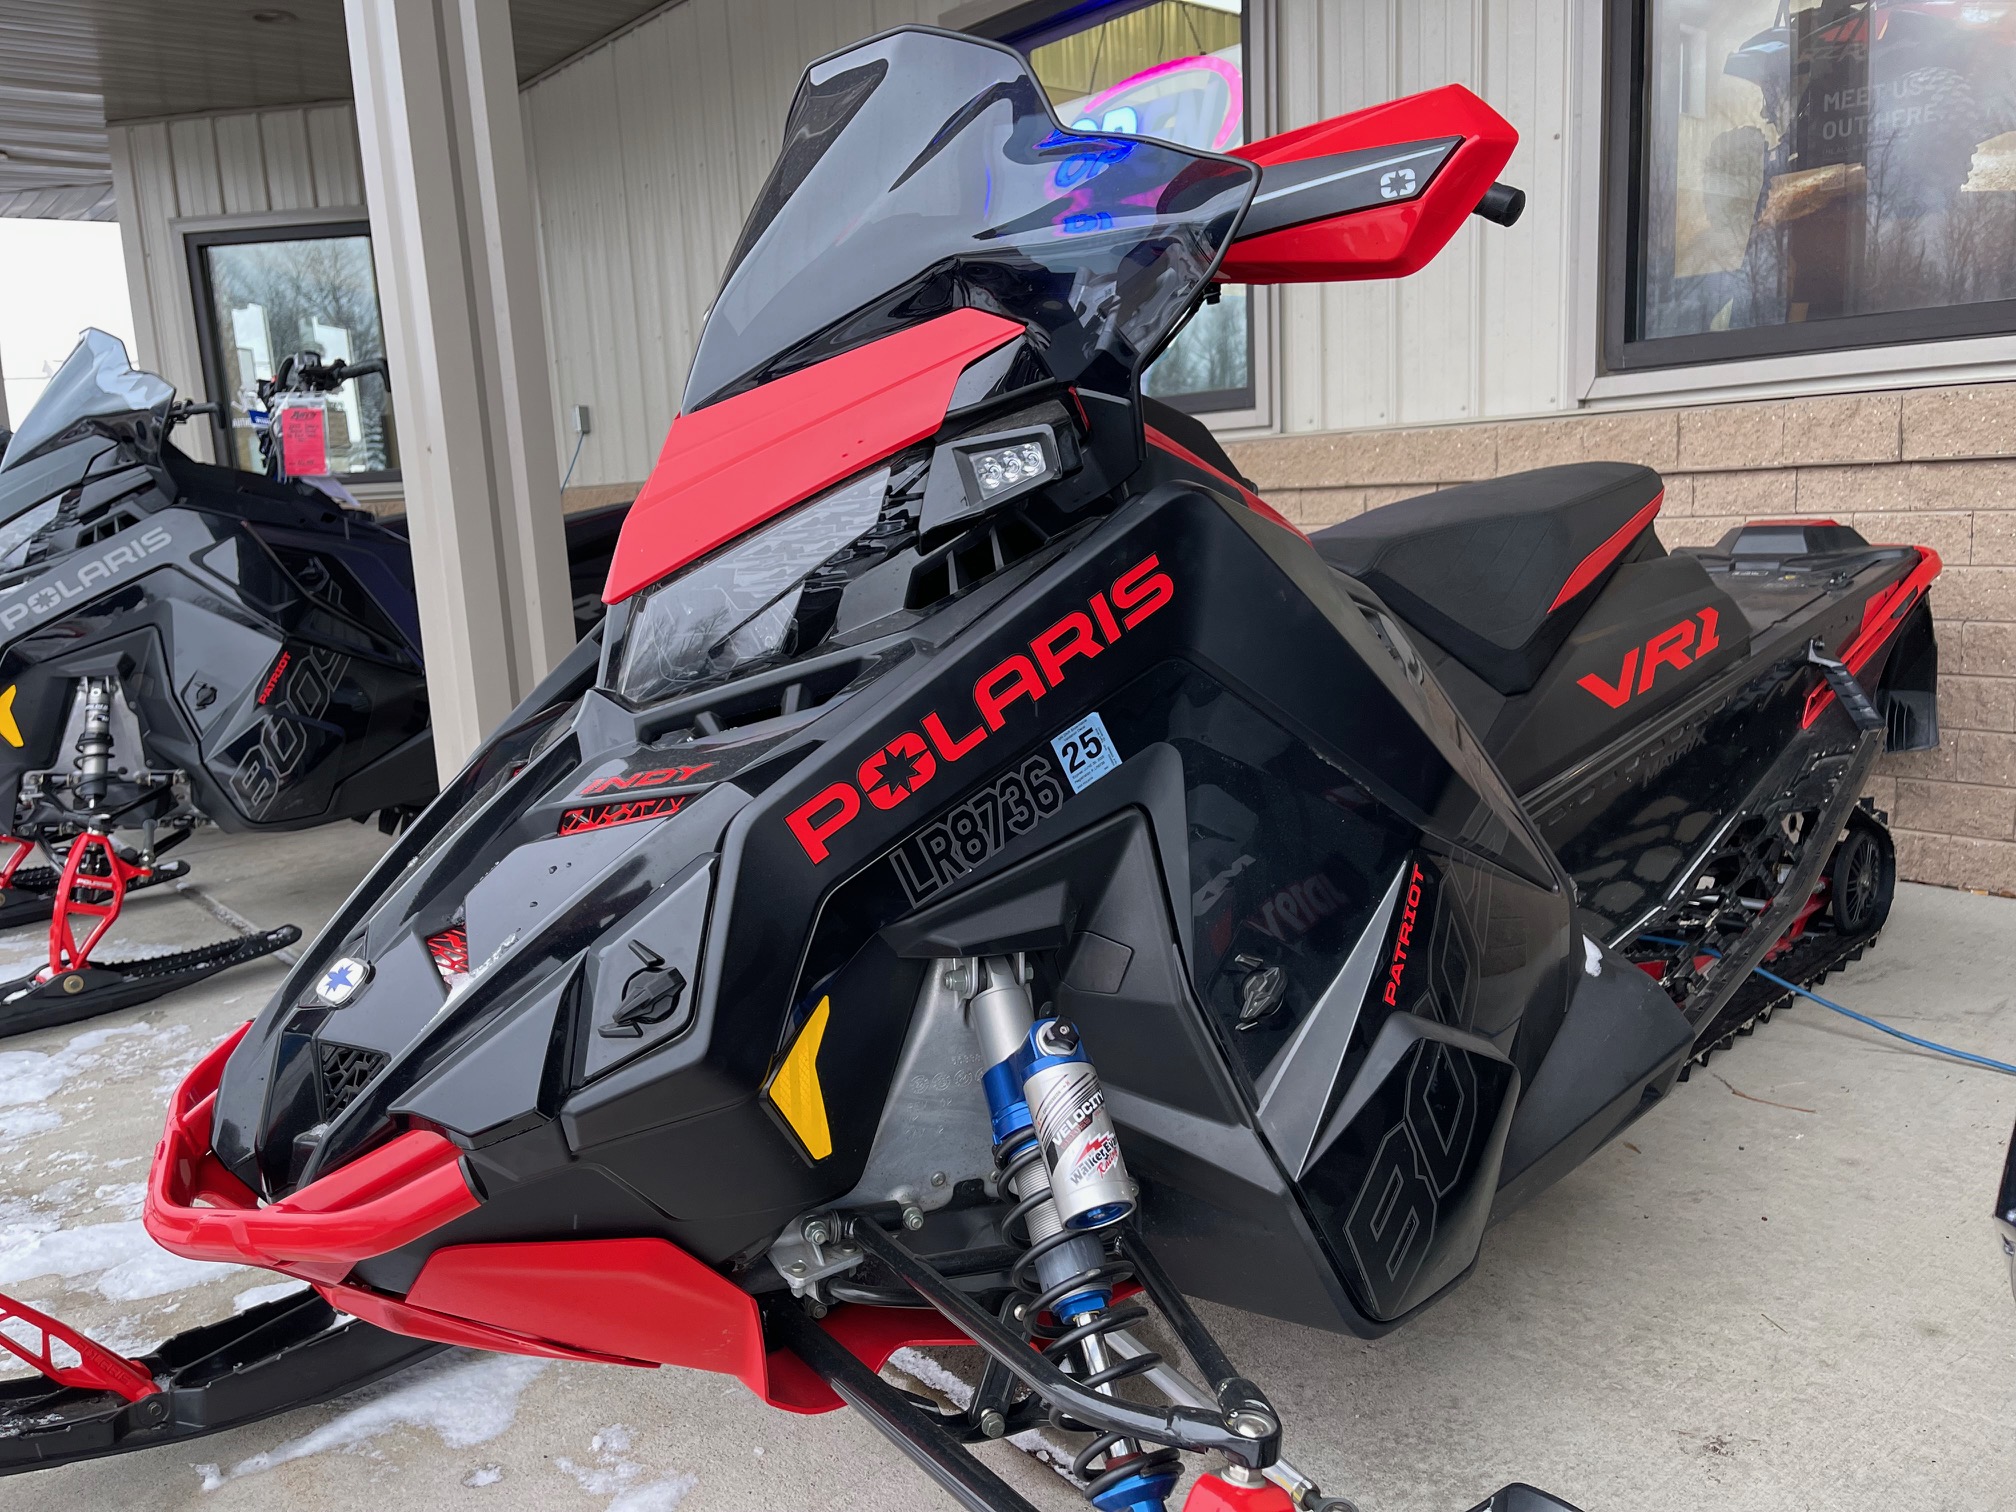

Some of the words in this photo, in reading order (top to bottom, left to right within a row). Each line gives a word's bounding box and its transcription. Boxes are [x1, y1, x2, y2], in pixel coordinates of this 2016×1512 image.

[0, 526, 173, 632] POLARIS
[258, 651, 291, 705] PATRIOT
[1576, 606, 1720, 709] VR1
[784, 553, 1174, 867] POLARIS
[1061, 727, 1103, 774] 25
[579, 761, 720, 798] INDY
[889, 754, 1064, 910] LR8736
[1383, 863, 1425, 1006] PATRIOT
[1052, 1089, 1104, 1146] VELOCITY
[1070, 1148, 1105, 1185] Walker
[74, 1340, 134, 1385] POLARIS
